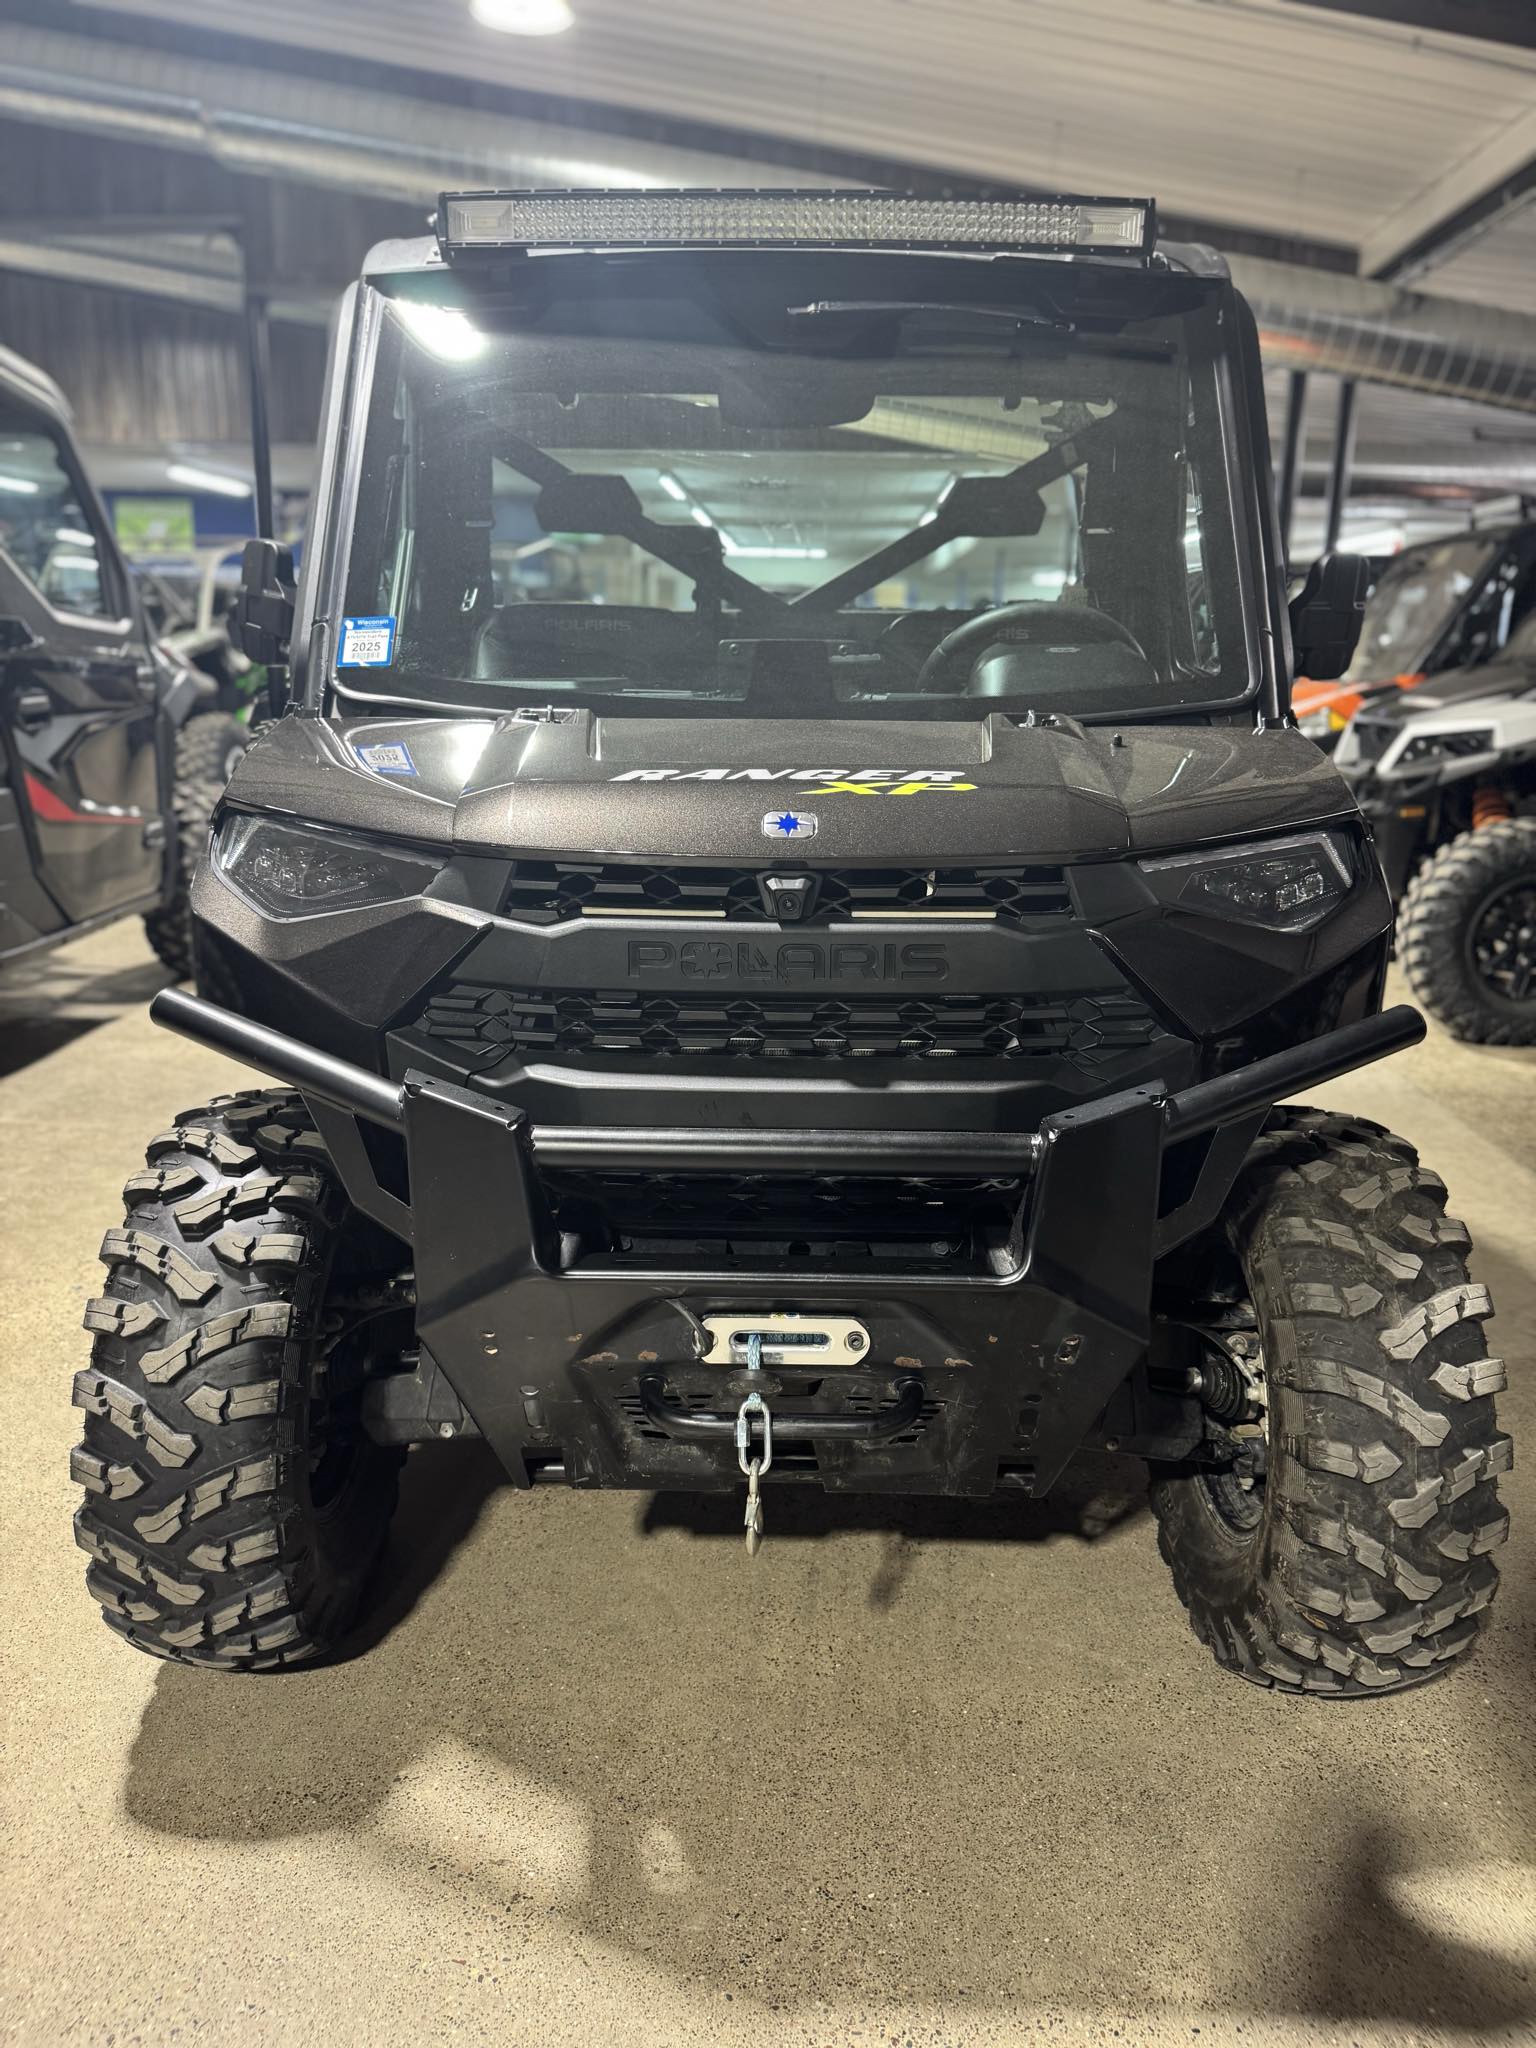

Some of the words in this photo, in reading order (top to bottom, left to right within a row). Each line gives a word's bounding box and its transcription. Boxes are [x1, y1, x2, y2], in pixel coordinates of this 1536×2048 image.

[352, 641, 381, 652] 2025
[608, 769, 966, 781] RANGER
[796, 781, 979, 795] XP
[627, 940, 949, 983] POLARIS
